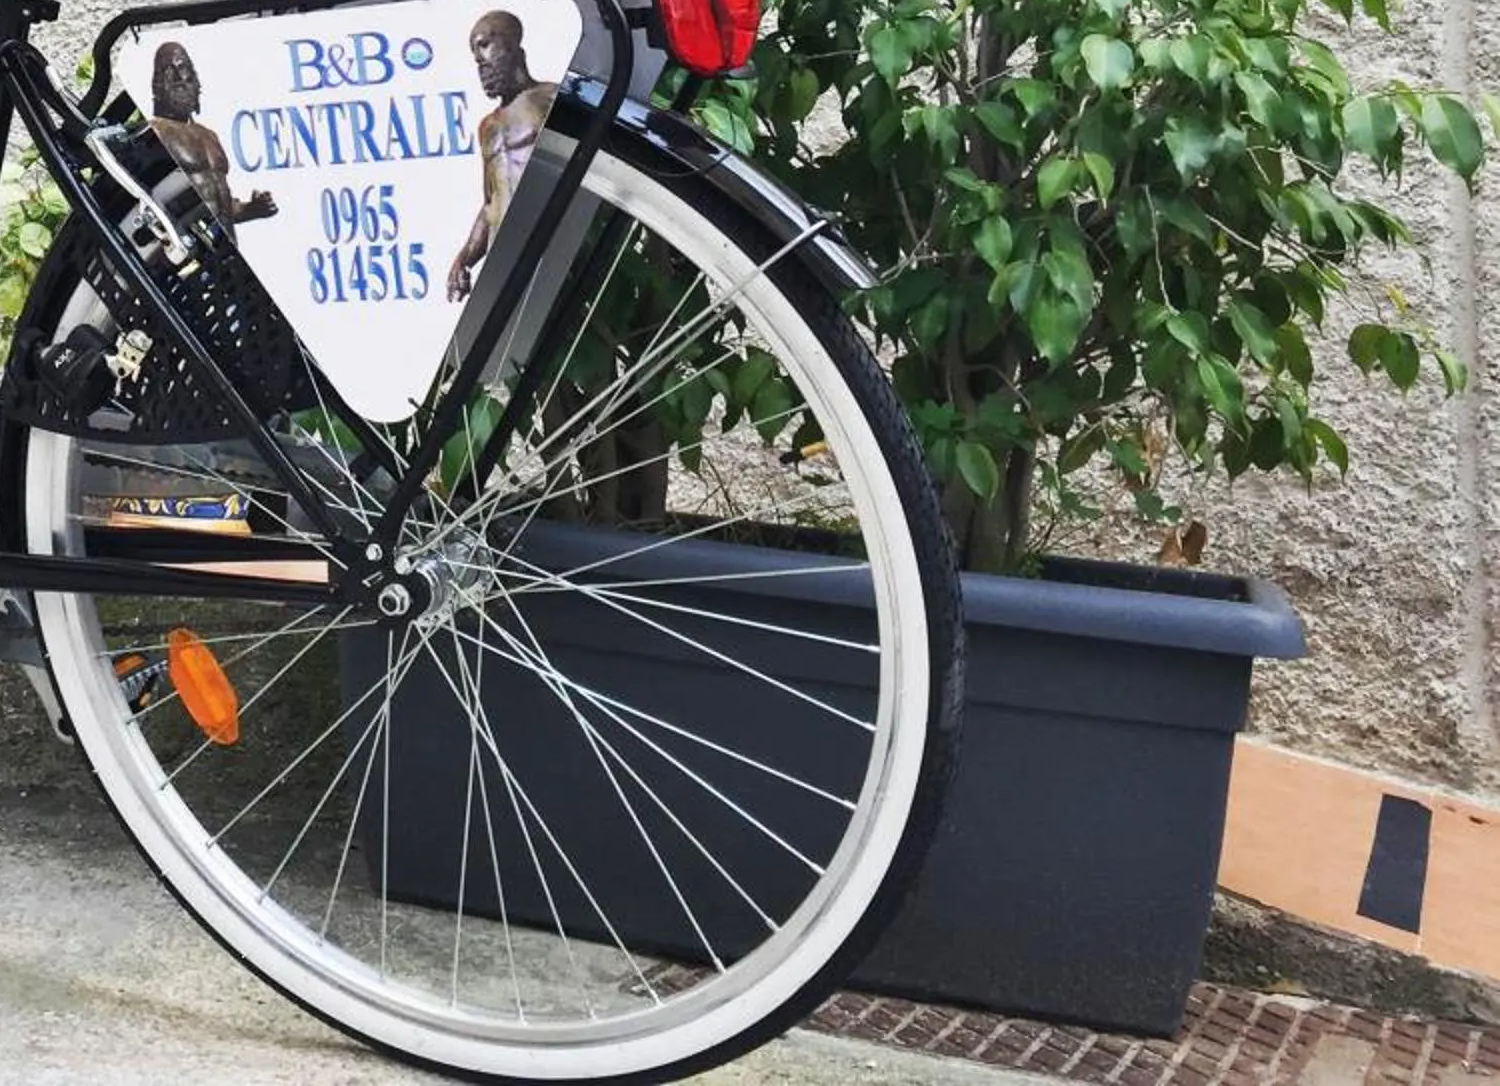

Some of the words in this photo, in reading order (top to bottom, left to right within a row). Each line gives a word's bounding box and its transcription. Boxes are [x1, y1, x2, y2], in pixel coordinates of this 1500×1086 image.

[284, 32, 395, 92] B&B
[231, 92, 475, 172] CENTRALE
[320, 185, 400, 245] 0965
[307, 242, 430, 304] 814515
